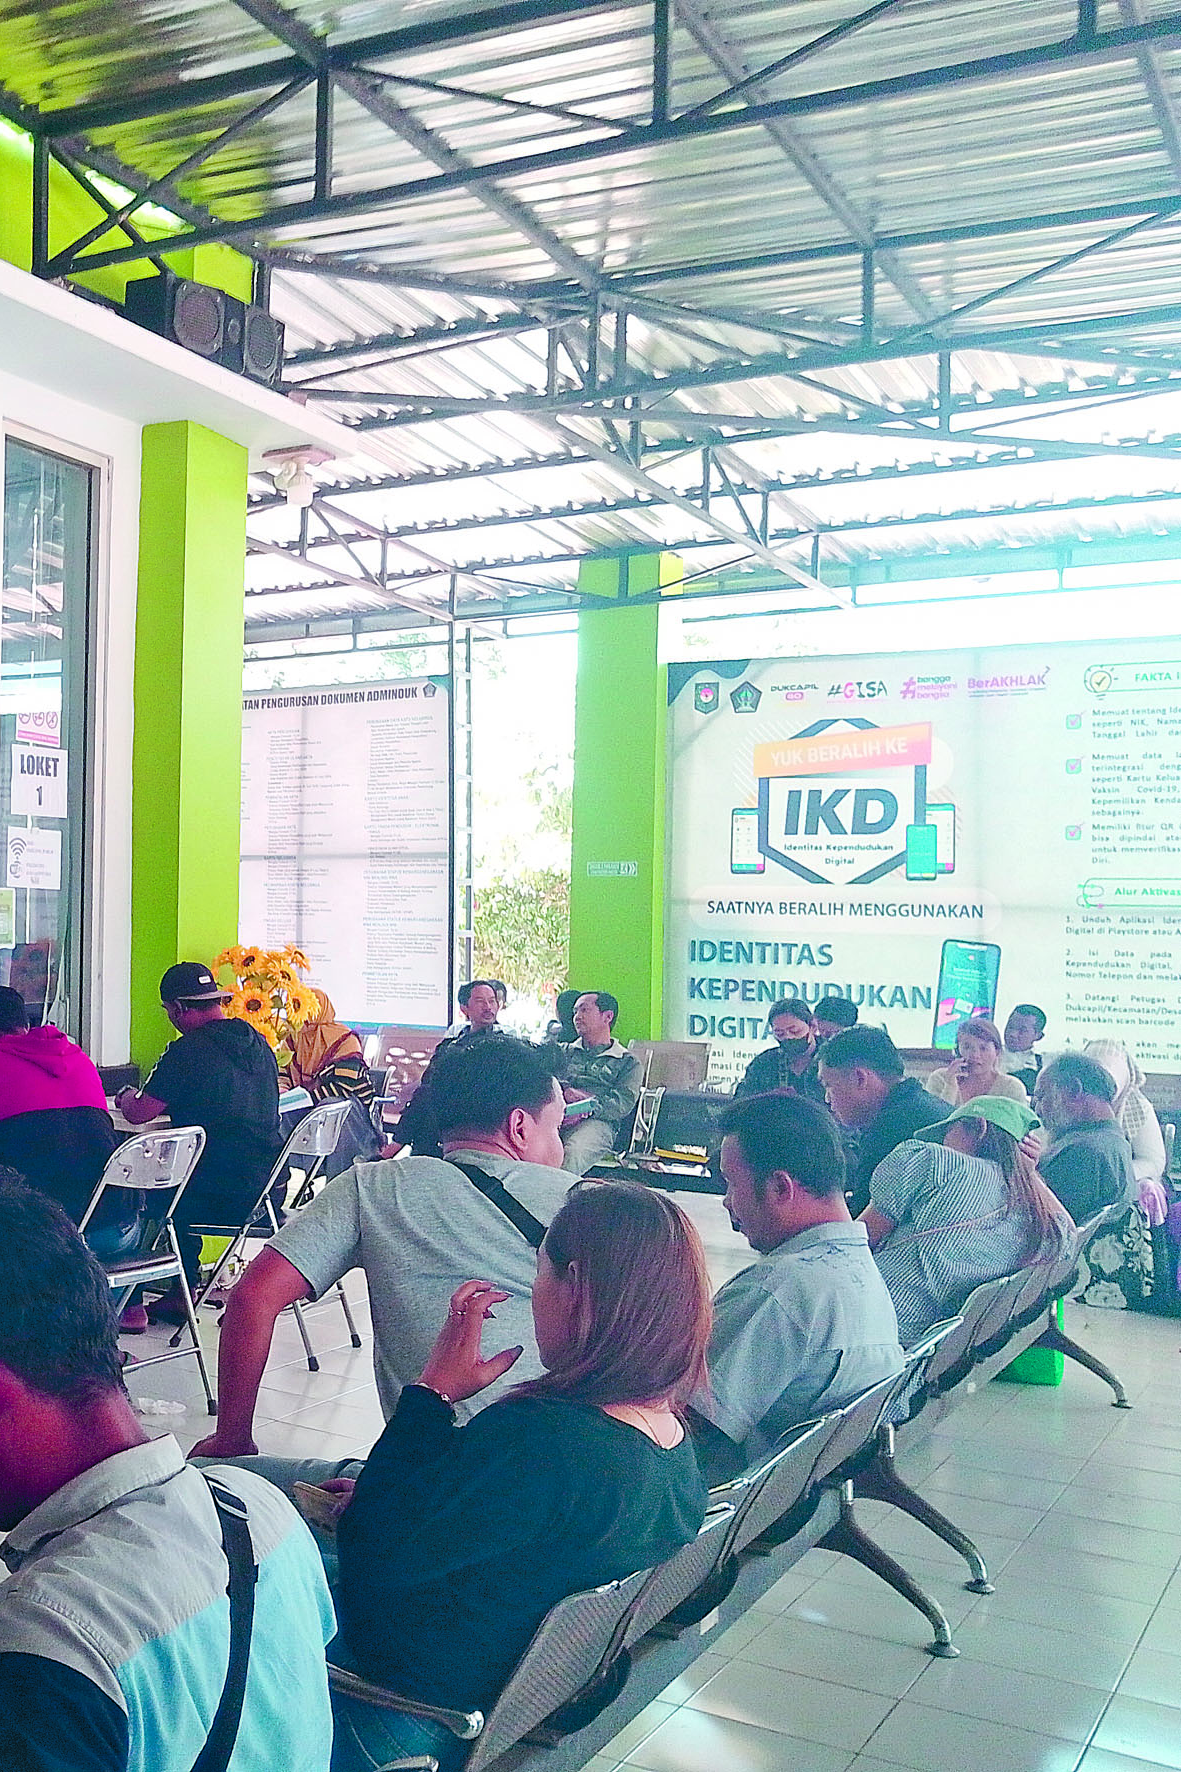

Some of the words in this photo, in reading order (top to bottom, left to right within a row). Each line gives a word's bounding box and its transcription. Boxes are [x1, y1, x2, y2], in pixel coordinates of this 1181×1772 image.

[968, 674, 1046, 689] BerAKHLAK
[1134, 672, 1172, 682] FAKTA
[770, 684, 819, 692] DUKCAPIL
[827, 680, 888, 699] #GISA
[261, 696, 319, 710] PENGURUSAN
[320, 692, 366, 706] DOKUMEN
[770, 748, 804, 767] YUK
[808, 740, 882, 764] BERALIH
[886, 736, 908, 755] KE
[20, 753, 60, 778] LOKET
[36, 786, 43, 806] 1
[784, 788, 899, 836] IKD
[784, 843, 823, 851] Identitas
[826, 843, 894, 853] Kependudukan
[824, 858, 854, 866] Digital
[1114, 888, 1138, 896] Alur
[707, 900, 775, 915] SAATNYA
[778, 902, 844, 917] BERALIH
[849, 903, 984, 919] MENGGUNAKAN
[690, 940, 834, 967] IDENTITAS
[689, 977, 932, 1010] KEPENDUDUKAN
